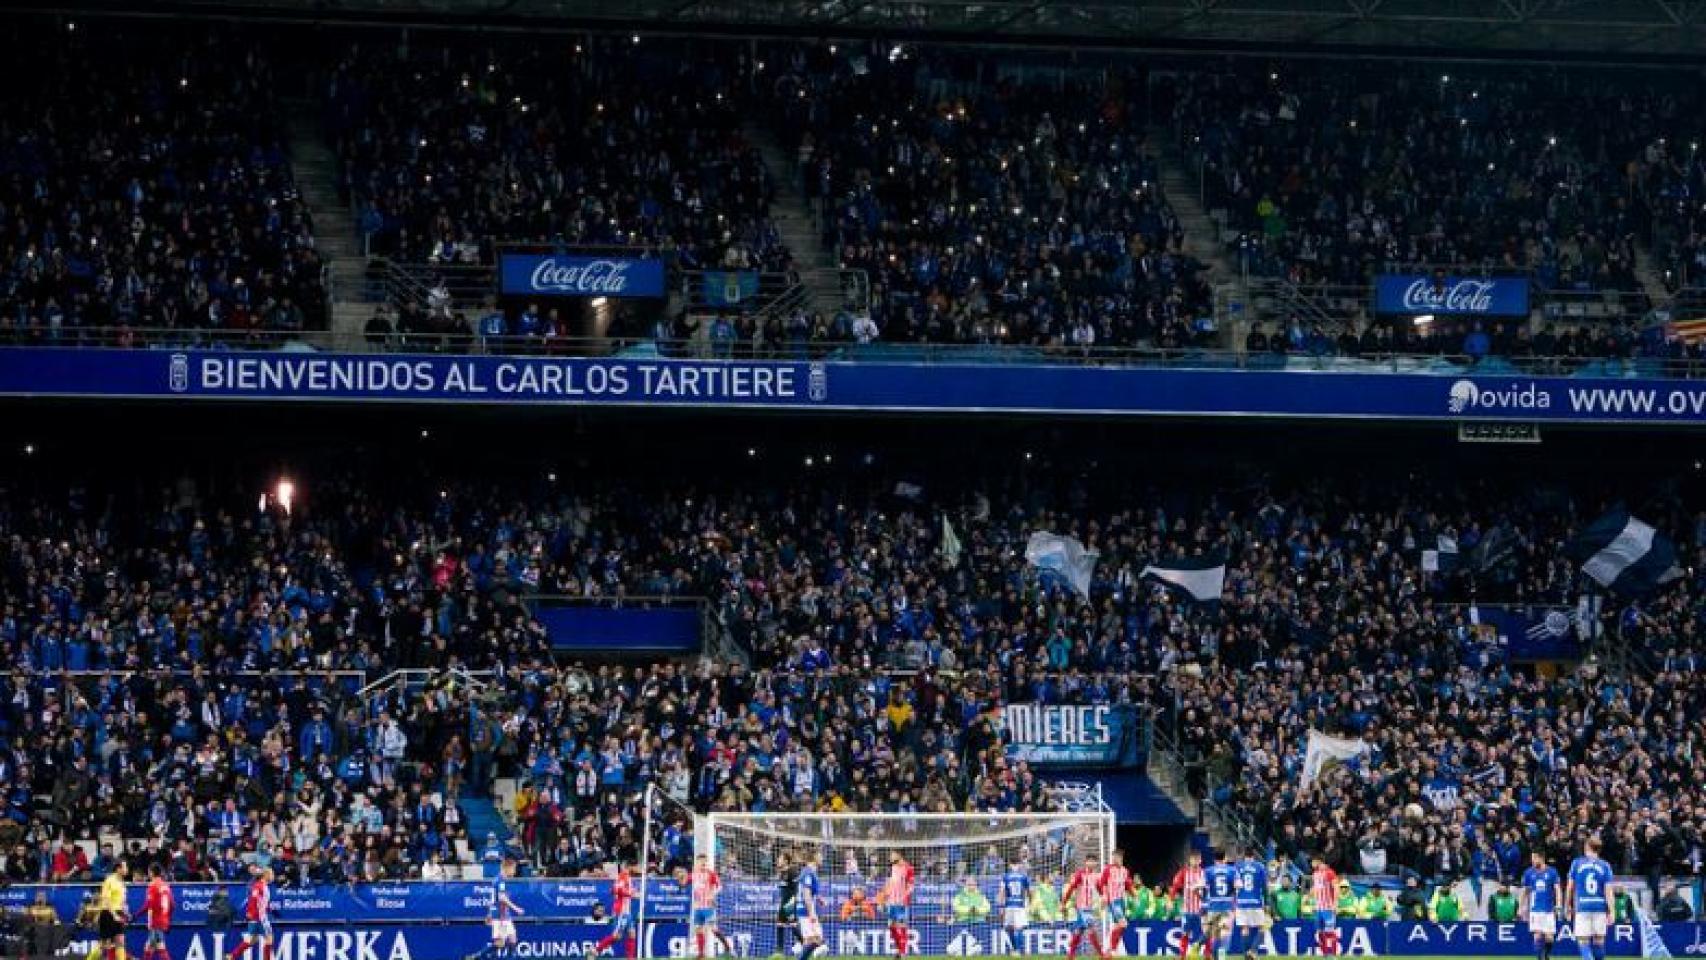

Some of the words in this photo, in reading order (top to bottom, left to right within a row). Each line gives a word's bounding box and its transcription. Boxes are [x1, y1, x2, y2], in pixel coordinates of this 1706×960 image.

[202, 358, 435, 391] BIENVENIDOS
[443, 363, 488, 392] AL
[496, 364, 630, 395] CARLOS
[637, 365, 795, 397] TARTIERE
[1481, 382, 1551, 408] ovida
[1007, 702, 1110, 744] MIERES
[1215, 873, 1228, 896] 5
[1585, 872, 1598, 895] 6
[1407, 924, 1518, 942] AYRE
